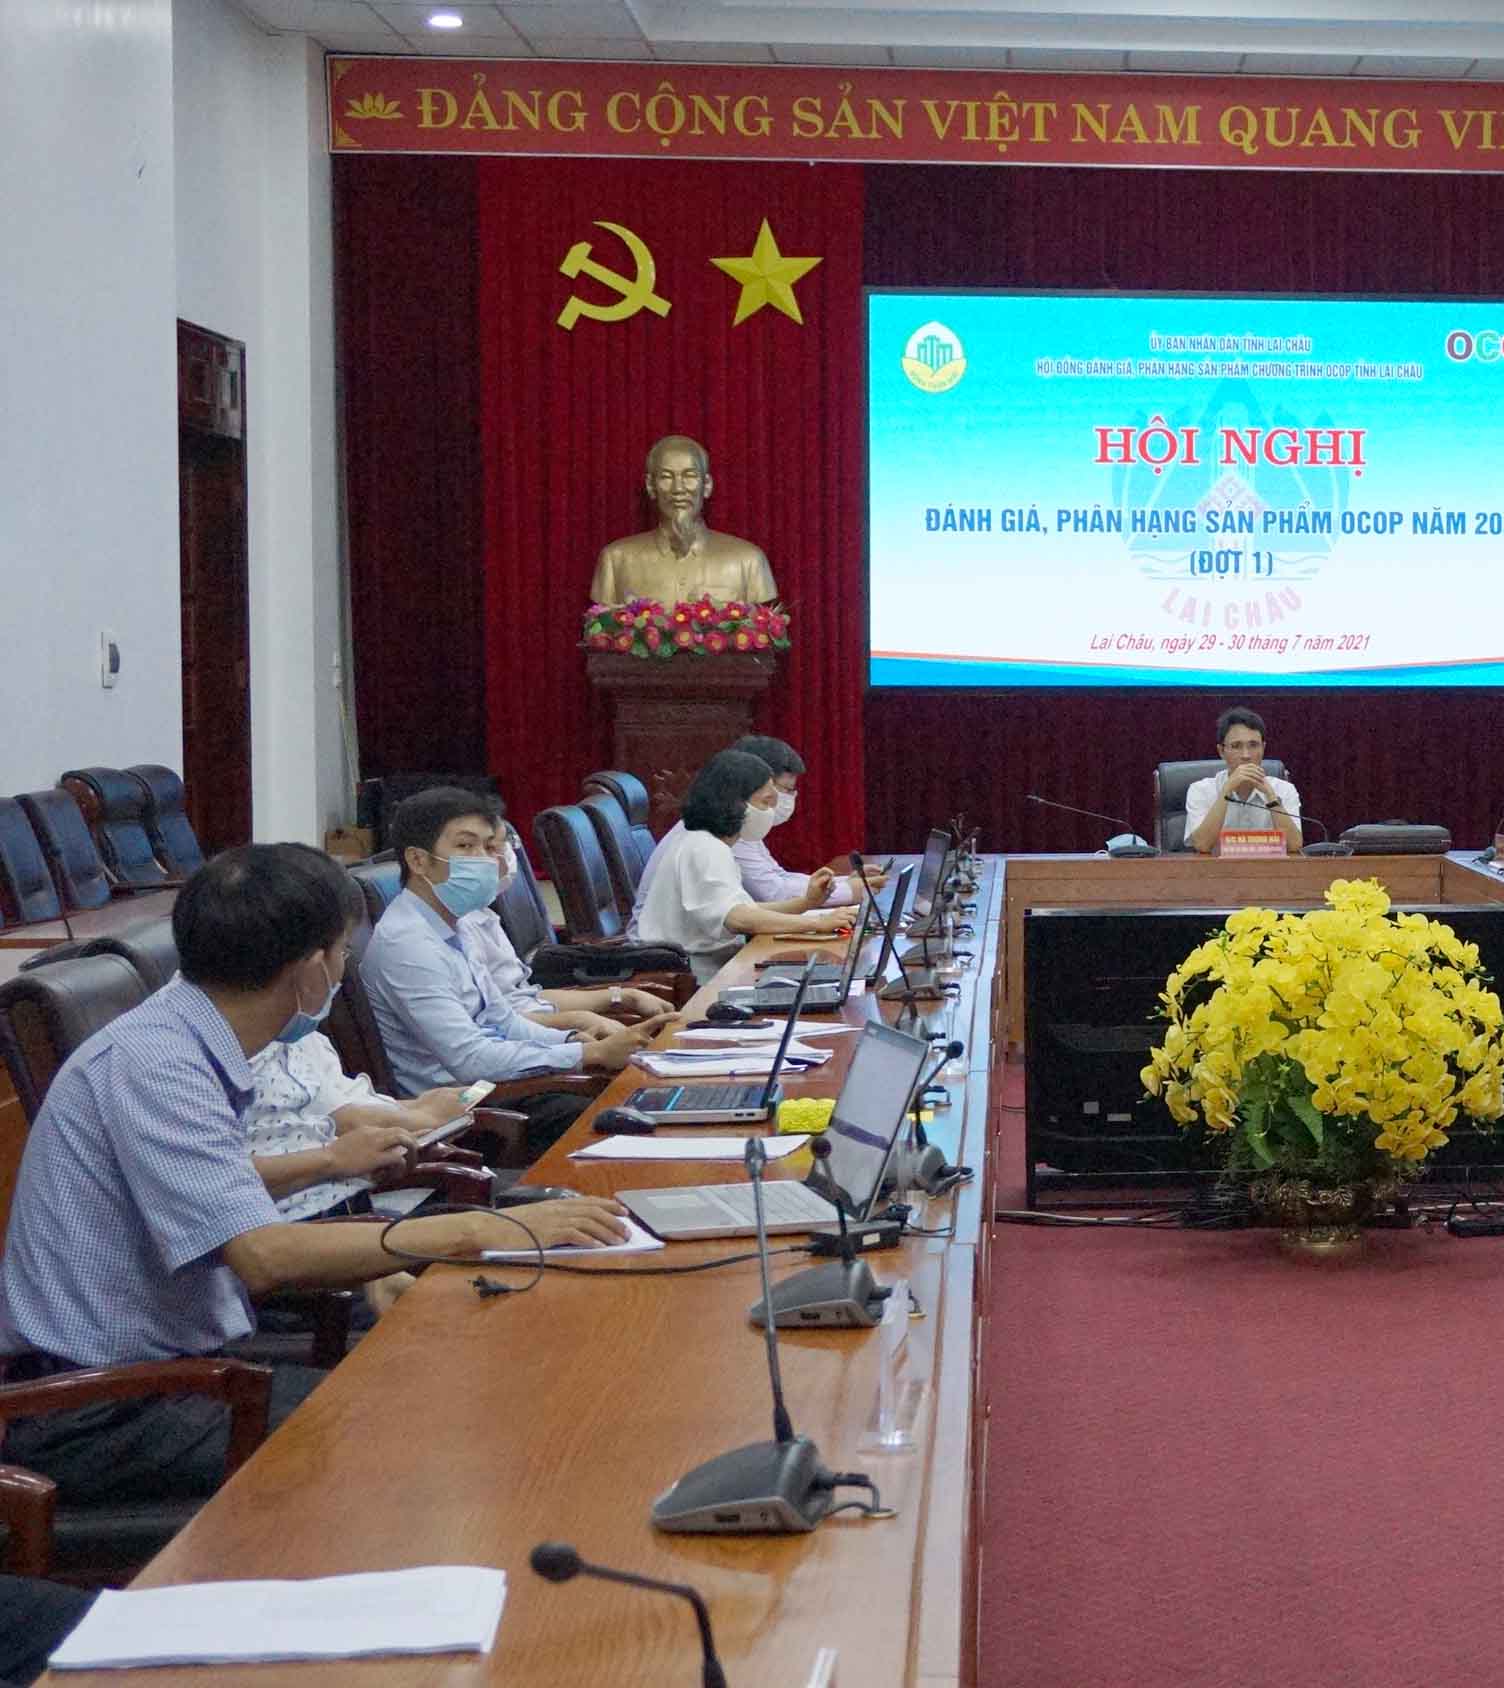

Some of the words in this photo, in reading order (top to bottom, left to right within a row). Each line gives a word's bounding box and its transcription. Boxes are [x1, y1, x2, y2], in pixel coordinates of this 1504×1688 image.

[416, 73, 587, 133] ĐẢNG
[606, 80, 772, 148] CỘNG
[792, 80, 906, 141] SẢN
[921, 90, 1059, 153] VIỆT
[1071, 100, 1201, 146] NAM
[1217, 105, 1423, 156] QUANG
[1166, 335, 1187, 350] BAN
[1267, 336, 1282, 352] LAI
[1326, 363, 1350, 378] OCOP
[1379, 364, 1394, 378] LAI
[1094, 415, 1200, 475] HỘI
[1220, 428, 1367, 477] NGHỊ
[925, 503, 992, 532] ĐÁNH
[1001, 504, 1048, 535] GIÁ,
[1056, 504, 1123, 533] PHÂN
[1131, 509, 1196, 538] HẠNG
[1205, 500, 1254, 534] SẢN
[1263, 500, 1332, 534] PHẨM
[1341, 510, 1404, 534] OCOP
[1412, 506, 1466, 535] NĂM
[1189, 549, 1243, 580] (ĐỢT
[1252, 550, 1273, 577] 1)
[1161, 587, 1211, 627] LAI
[1090, 634, 1112, 650] Lai
[1116, 633, 1155, 652] Châu,
[1161, 634, 1196, 654] ngày
[1200, 634, 1217, 650] 29
[1227, 634, 1246, 650] 30
[1248, 634, 1289, 654] tháng
[1292, 634, 1302, 650] 7
[1303, 635, 1334, 650] năm
[1338, 634, 1371, 650] 2021
